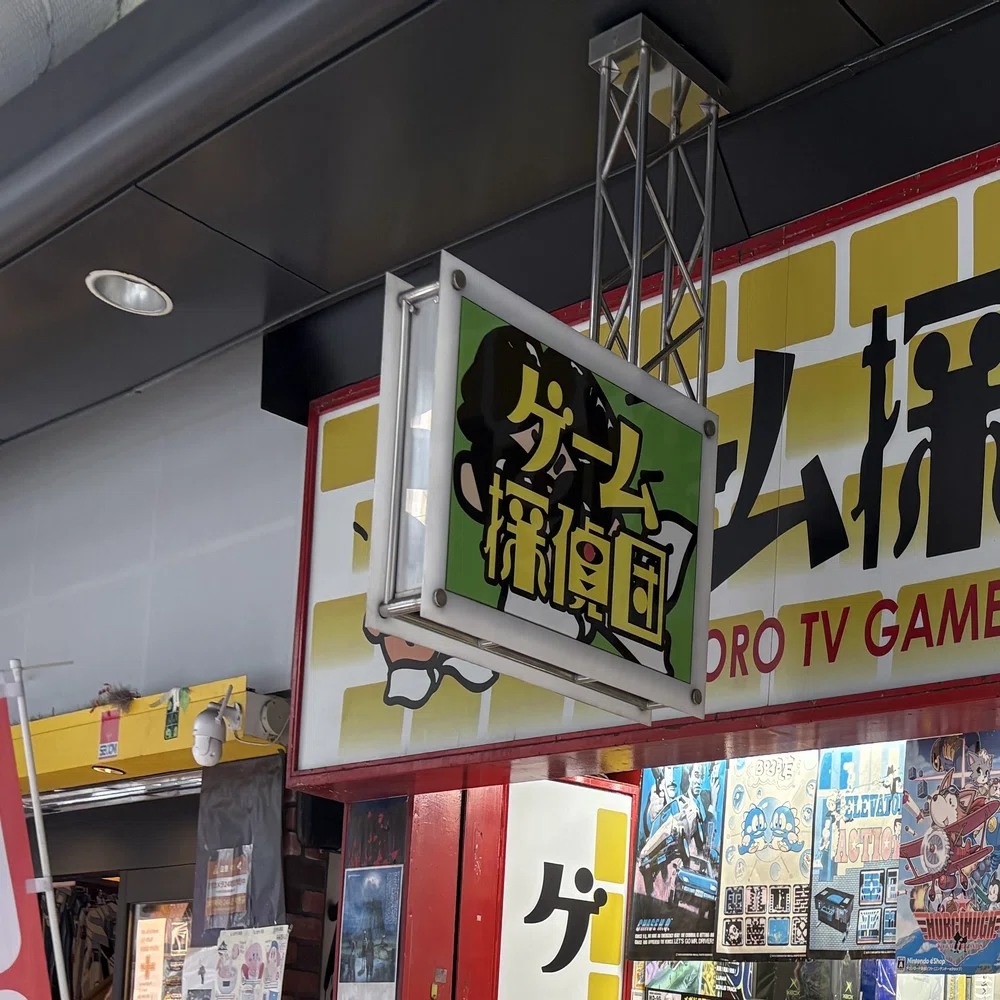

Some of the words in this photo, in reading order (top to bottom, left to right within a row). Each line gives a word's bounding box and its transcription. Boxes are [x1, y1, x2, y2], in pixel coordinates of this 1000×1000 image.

[506, 363, 664, 531] ゲーム
[486, 471, 669, 646] 探偵団
[707, 617, 785, 682] ORO
[800, 606, 850, 667] TV
[907, 957, 929, 965] Nintendo
